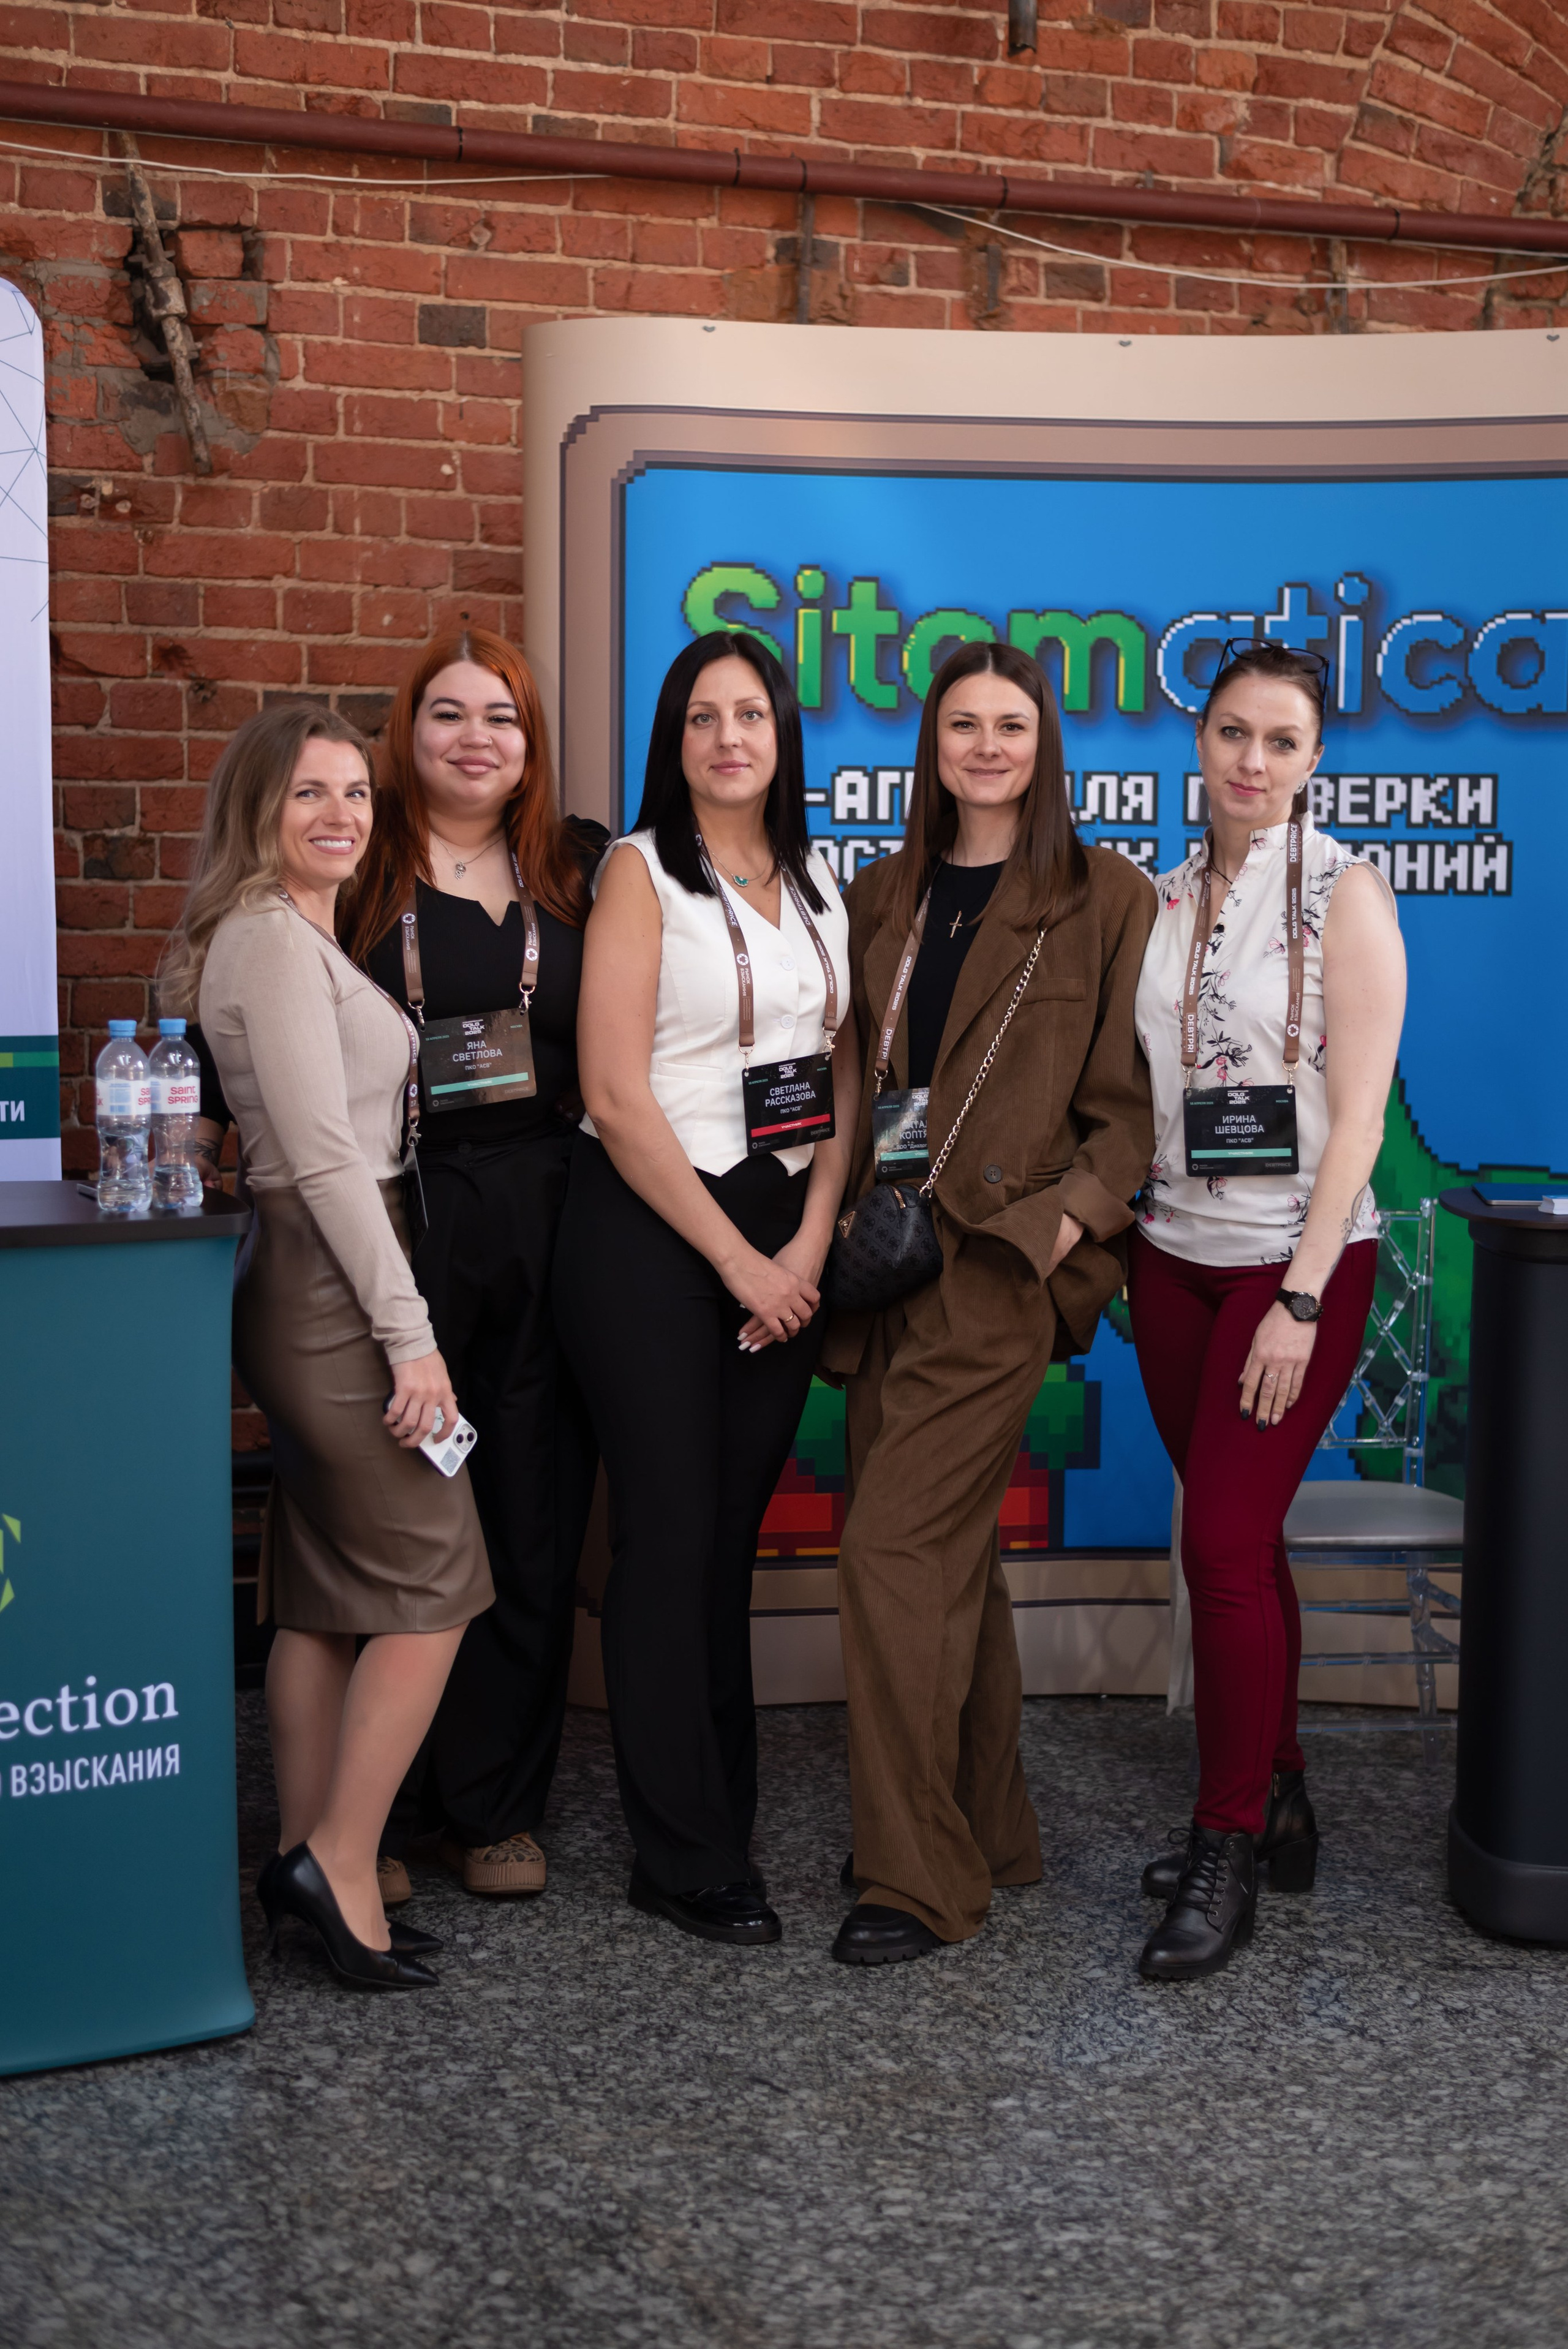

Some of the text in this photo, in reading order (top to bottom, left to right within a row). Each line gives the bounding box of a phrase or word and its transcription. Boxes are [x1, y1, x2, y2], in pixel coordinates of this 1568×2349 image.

[789, 886, 811, 926] DEBTPRICE
[892, 956, 911, 1011] DOLG TALK 2025
[402, 1014, 417, 1065] DEBTPRICE
[467, 1041, 486, 1050] ЯНА
[881, 1028, 892, 1060] DEBTP
[452, 1049, 503, 1062] СВЕТЛОВА
[769, 1082, 811, 1096] СВЕТЛАНА
[766, 1090, 816, 1107] РАССКАЗОВА
[1223, 1115, 1256, 1124] ИРИНА
[1215, 1125, 1264, 1134] ШЕВЦОВА
[11, 1743, 179, 1797] ВЗЫСКАНИЯ
